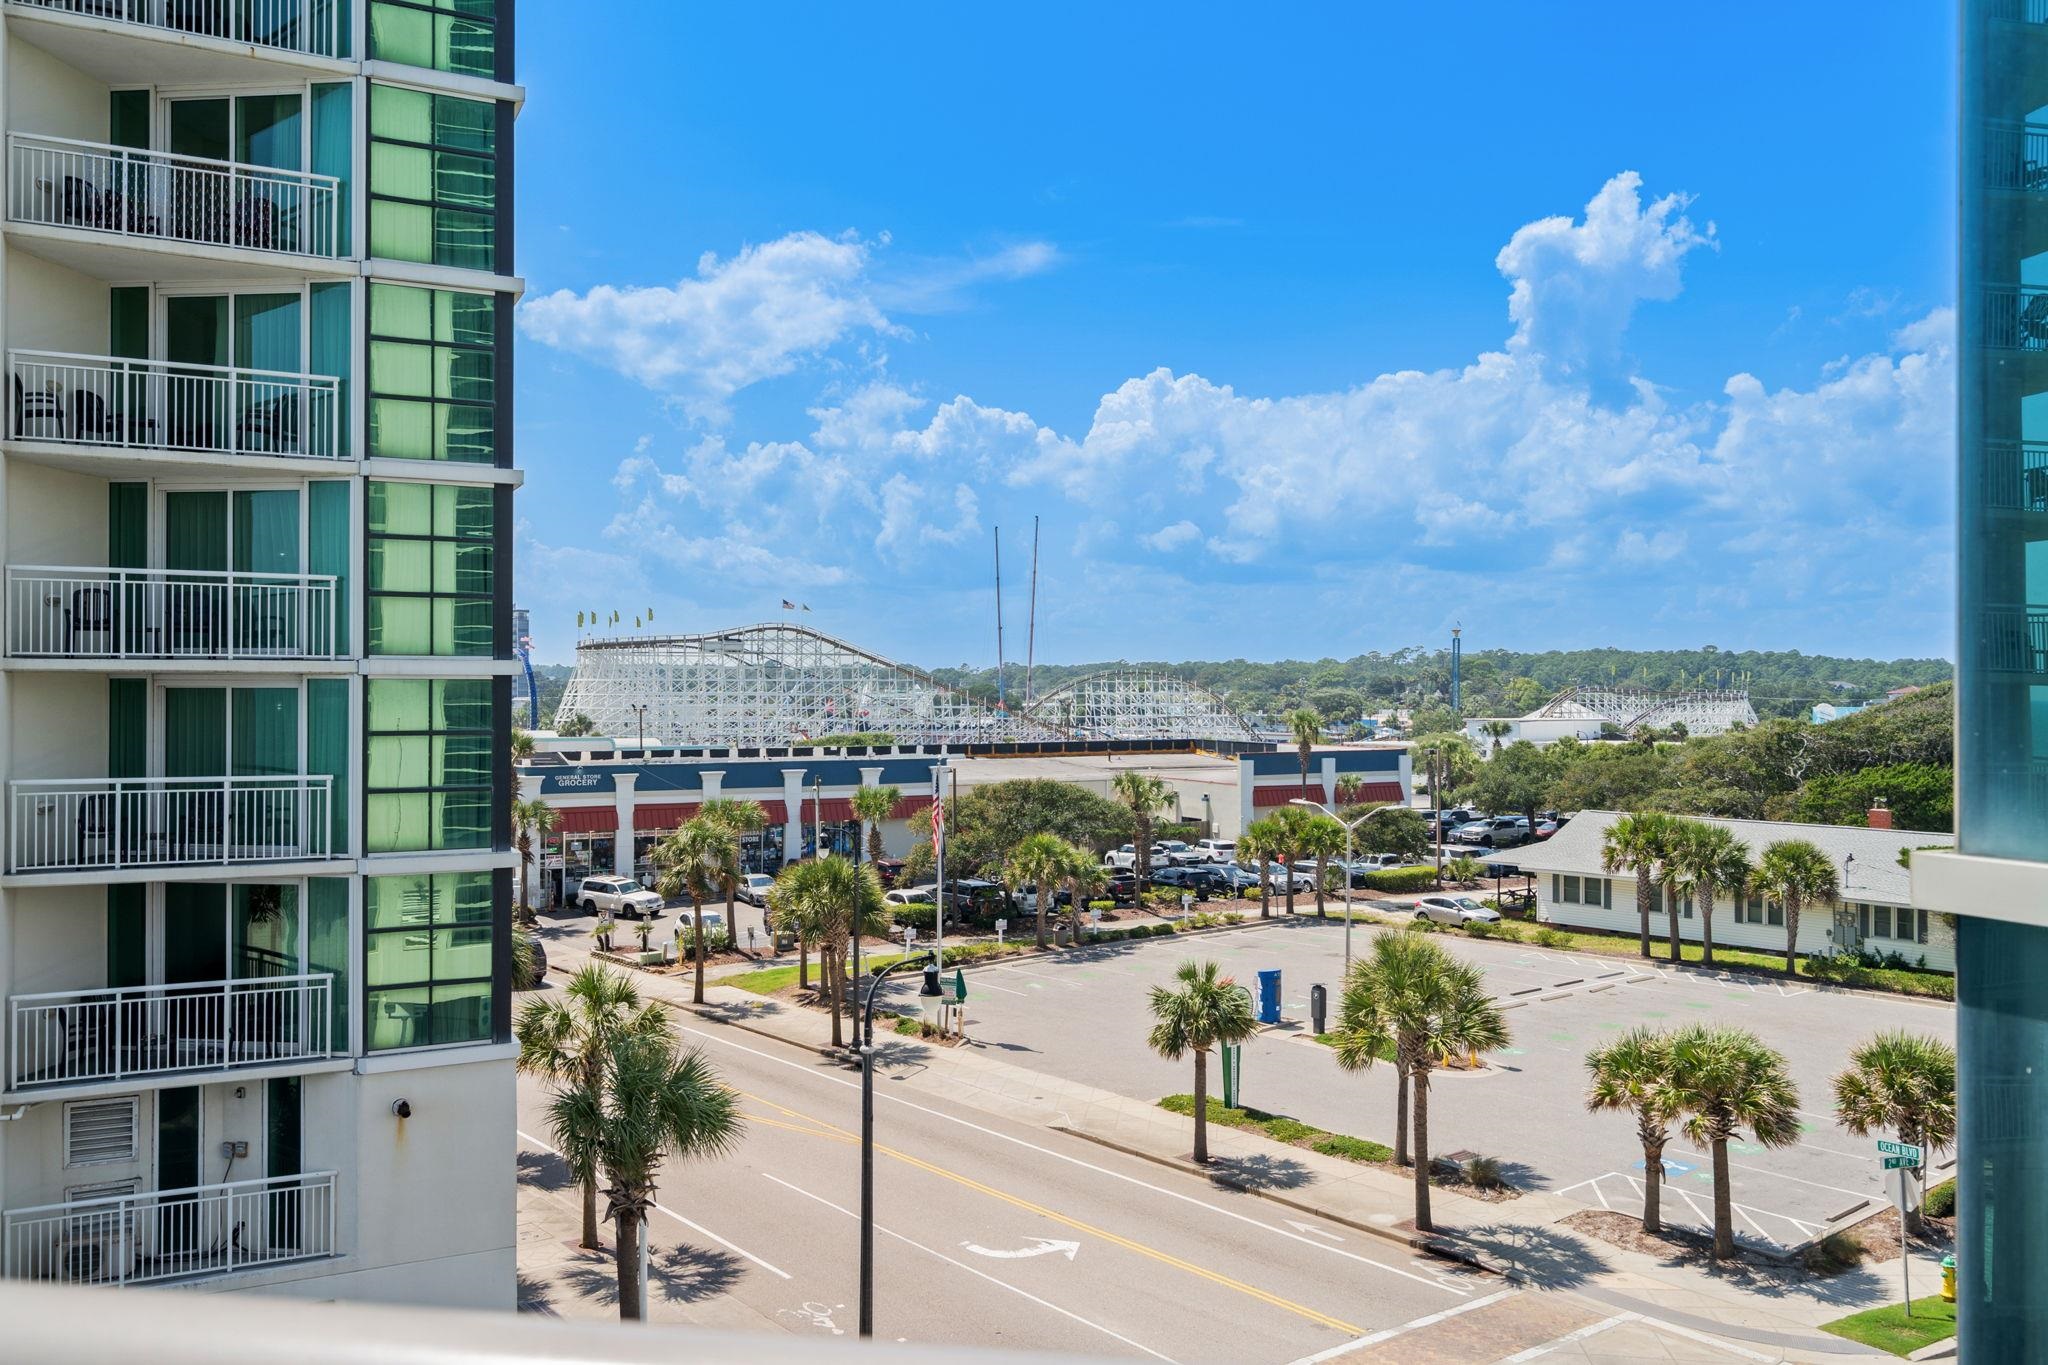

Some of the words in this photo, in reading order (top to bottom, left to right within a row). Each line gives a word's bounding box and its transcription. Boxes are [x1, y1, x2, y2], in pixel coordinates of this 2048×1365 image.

[1880, 1142, 1900, 1155] OCEAN
[1901, 1146, 1917, 1158] BLVD
[1899, 1158, 1909, 1167] AVE
